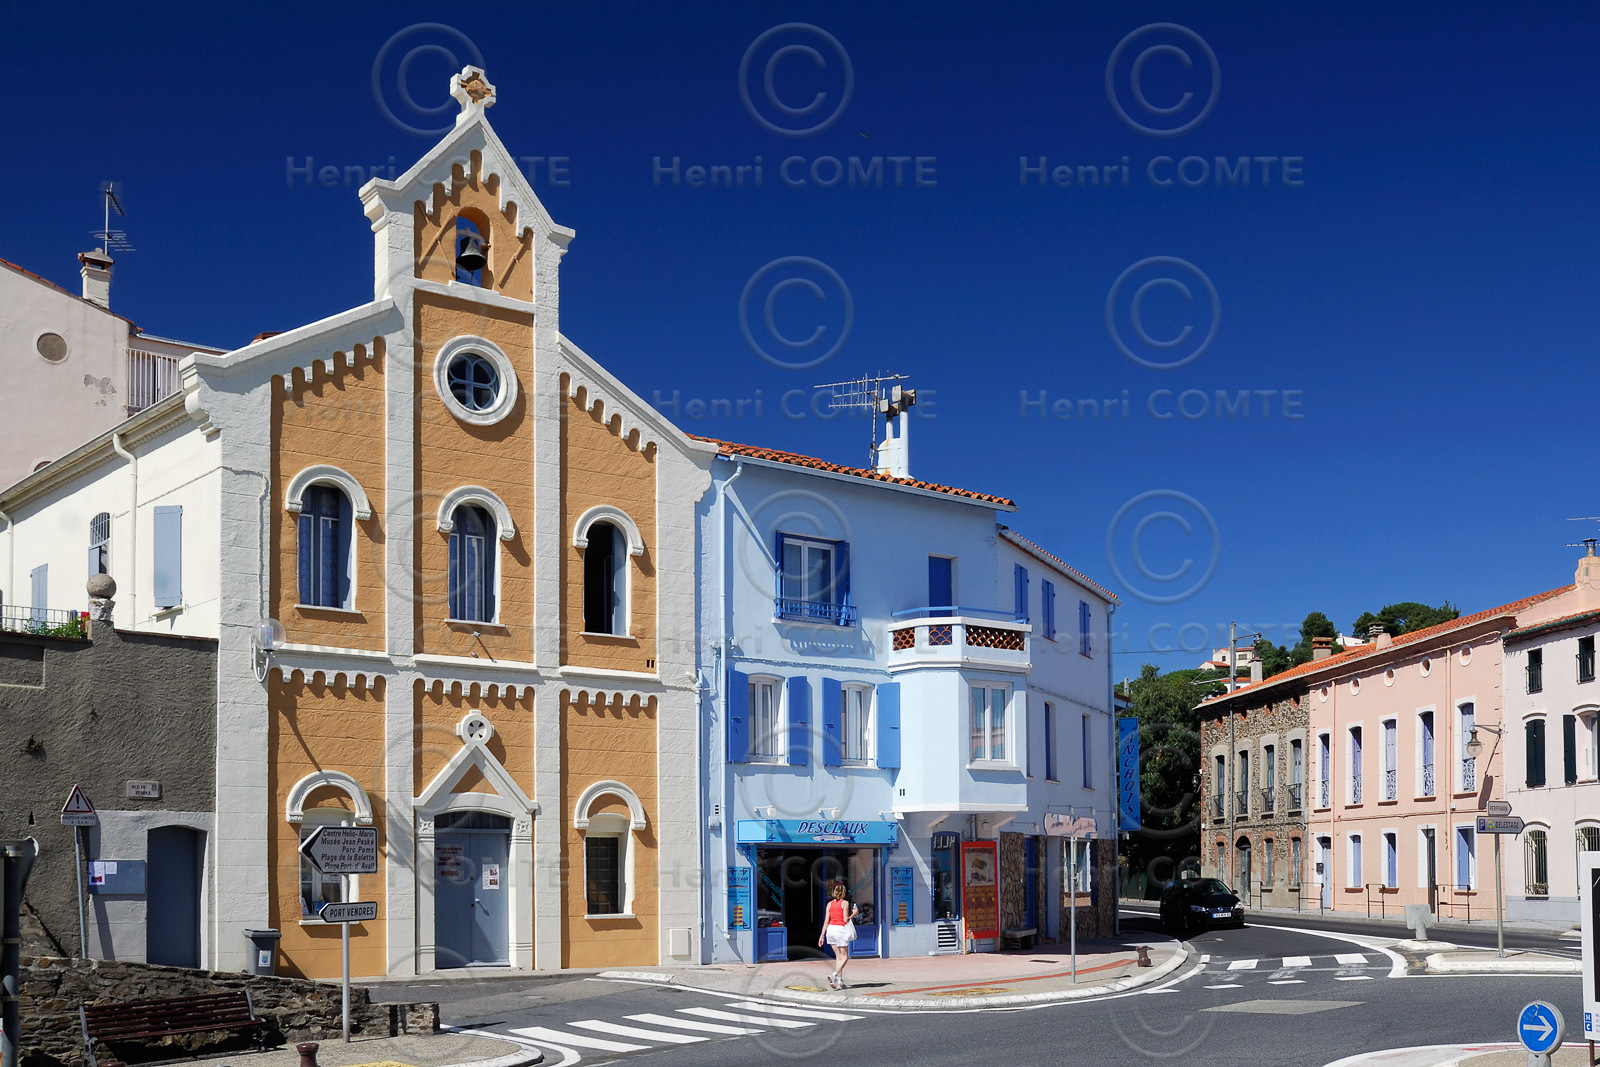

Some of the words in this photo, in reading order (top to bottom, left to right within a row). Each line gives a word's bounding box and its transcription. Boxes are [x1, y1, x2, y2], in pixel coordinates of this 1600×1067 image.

[1122, 732, 1136, 815] ANCHOIS
[796, 821, 869, 834] DESCLAUX
[1480, 820, 1485, 829] P
[325, 862, 340, 870] Plage
[329, 908, 345, 918] PORT
[347, 906, 374, 917] VENDRES
